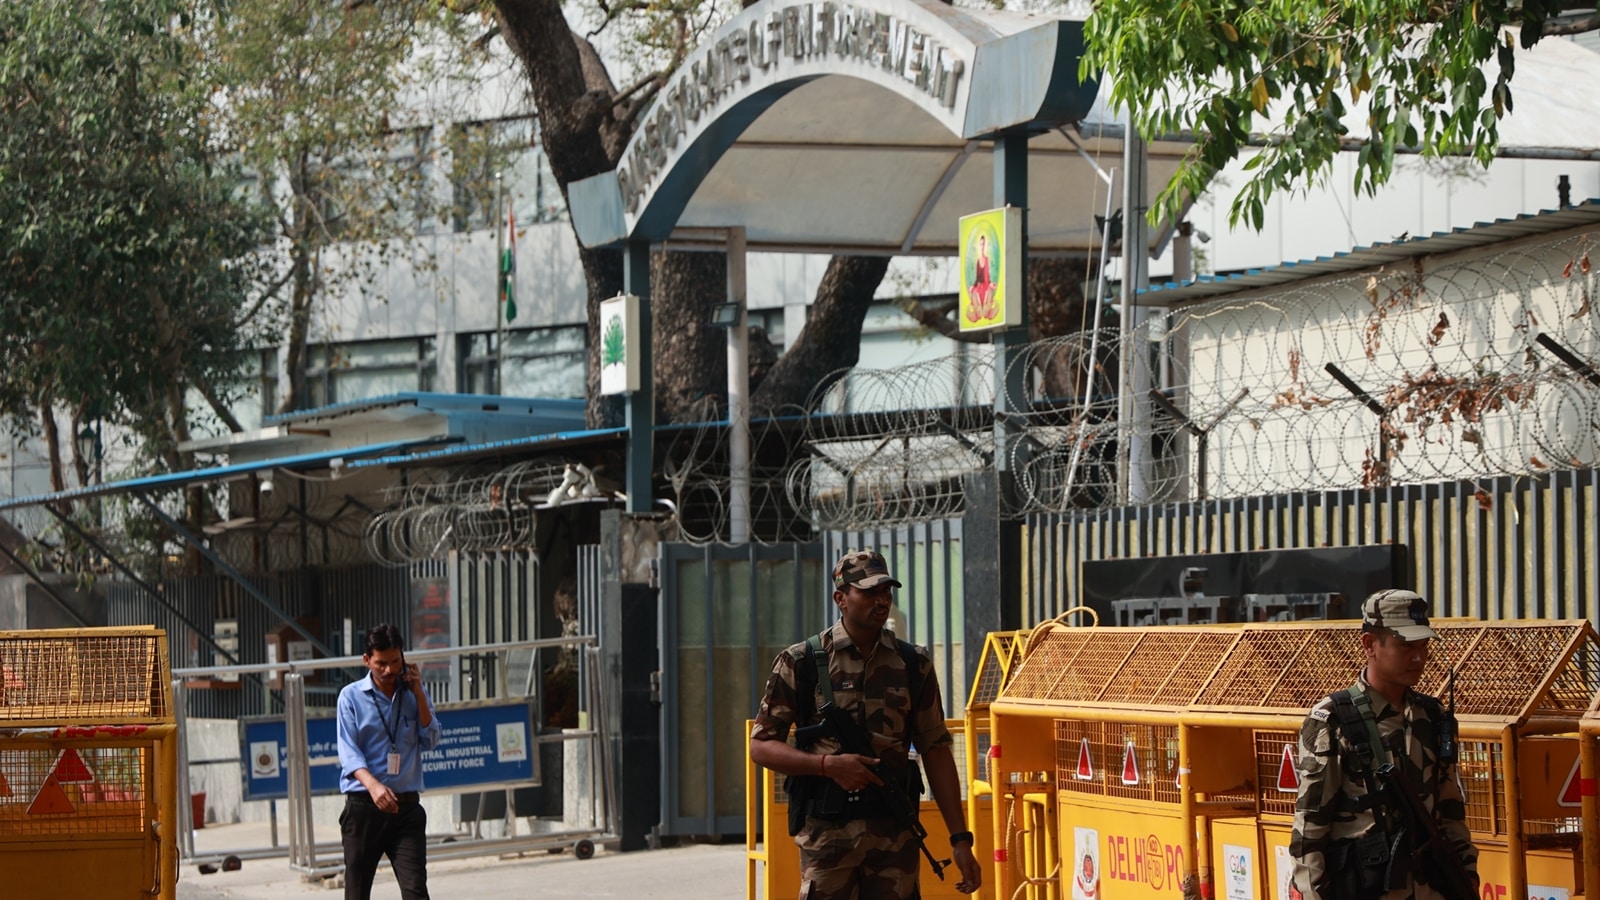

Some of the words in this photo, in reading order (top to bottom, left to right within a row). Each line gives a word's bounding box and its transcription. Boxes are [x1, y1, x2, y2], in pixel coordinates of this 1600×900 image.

[749, 11, 782, 69] OF
[783, 1, 964, 109] ENFORCEMENT
[442, 726, 481, 736] CO-OPERATE
[438, 737, 457, 746] URITY
[458, 735, 481, 743] CHECK
[446, 745, 493, 758] INDUSTRIAL
[422, 760, 457, 772] ECURITY
[458, 757, 485, 768] FORCE
[1108, 835, 1148, 883] DELHI
[1230, 854, 1247, 876] G20
